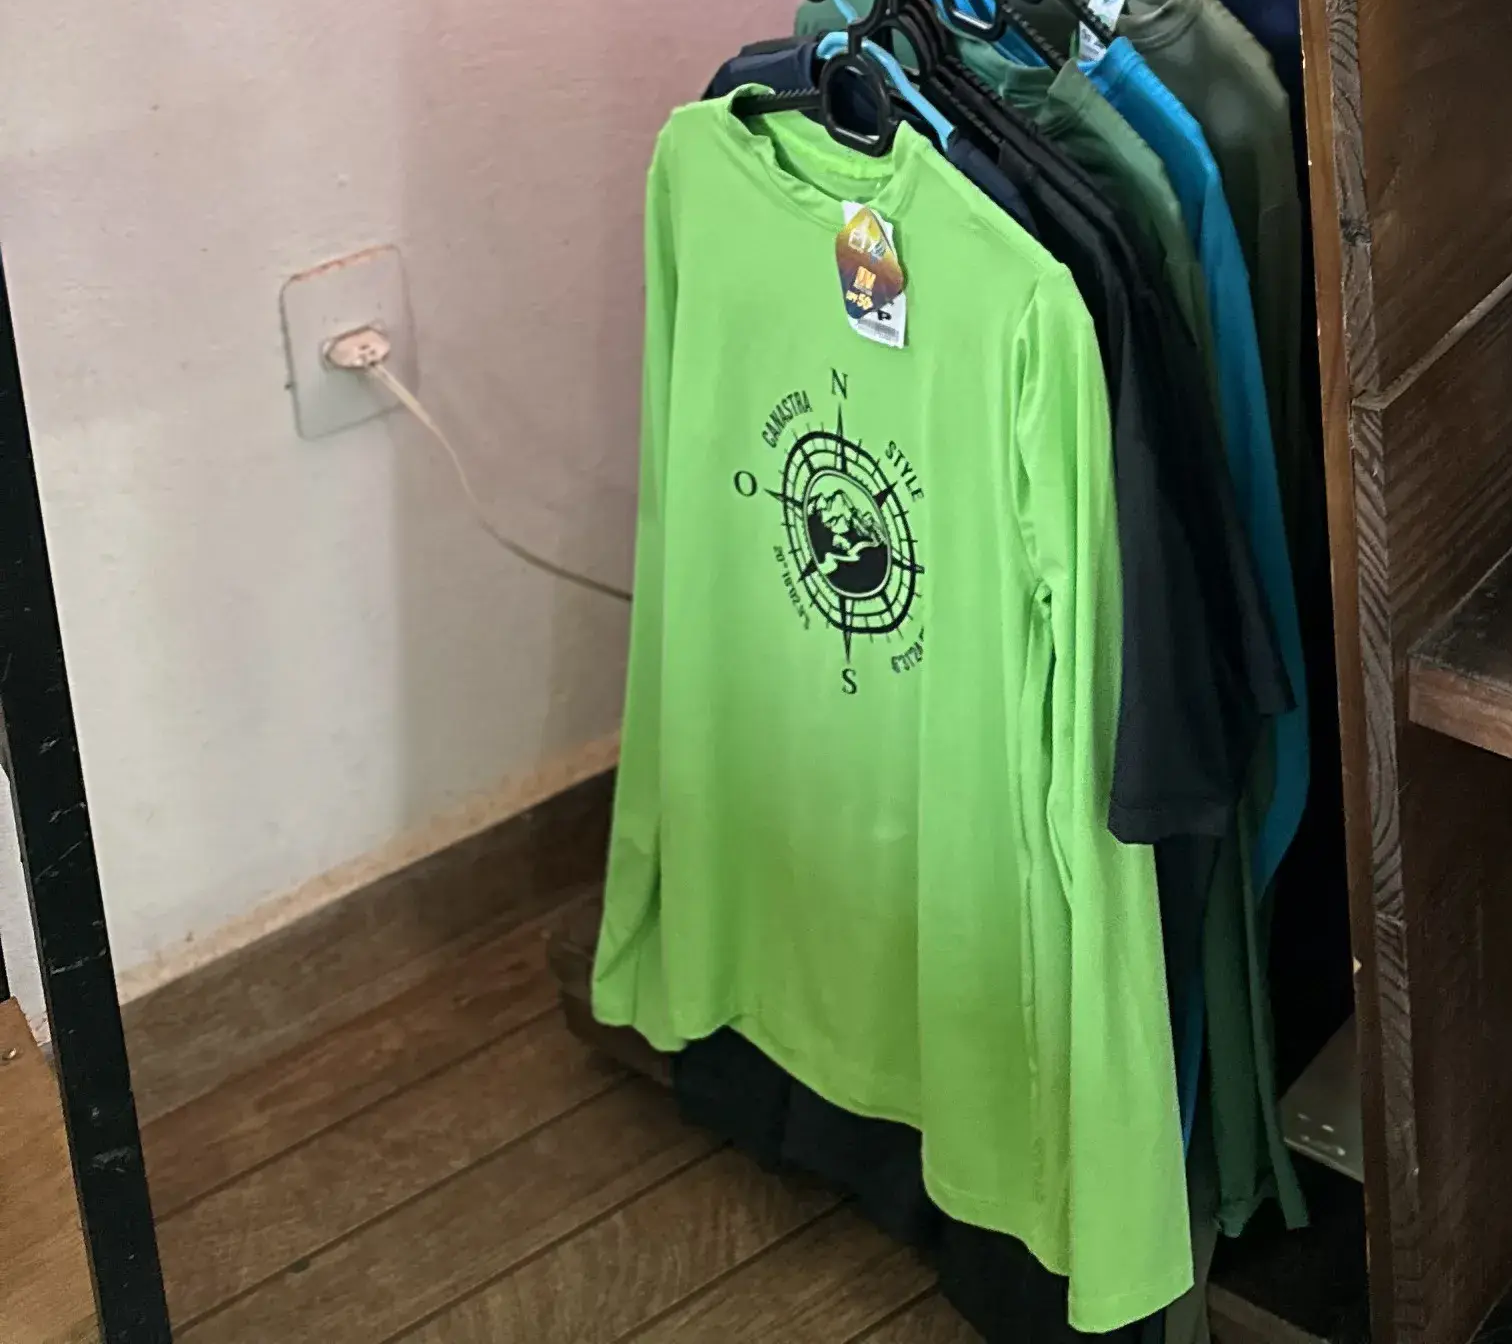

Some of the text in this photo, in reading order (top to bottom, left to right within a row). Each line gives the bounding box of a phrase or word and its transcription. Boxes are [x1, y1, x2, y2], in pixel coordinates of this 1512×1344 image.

[830, 367, 848, 399] N
[762, 390, 814, 448] CANASTRA
[733, 470, 757, 497] O
[885, 440, 925, 503] STYLE
[842, 668, 858, 695] S
